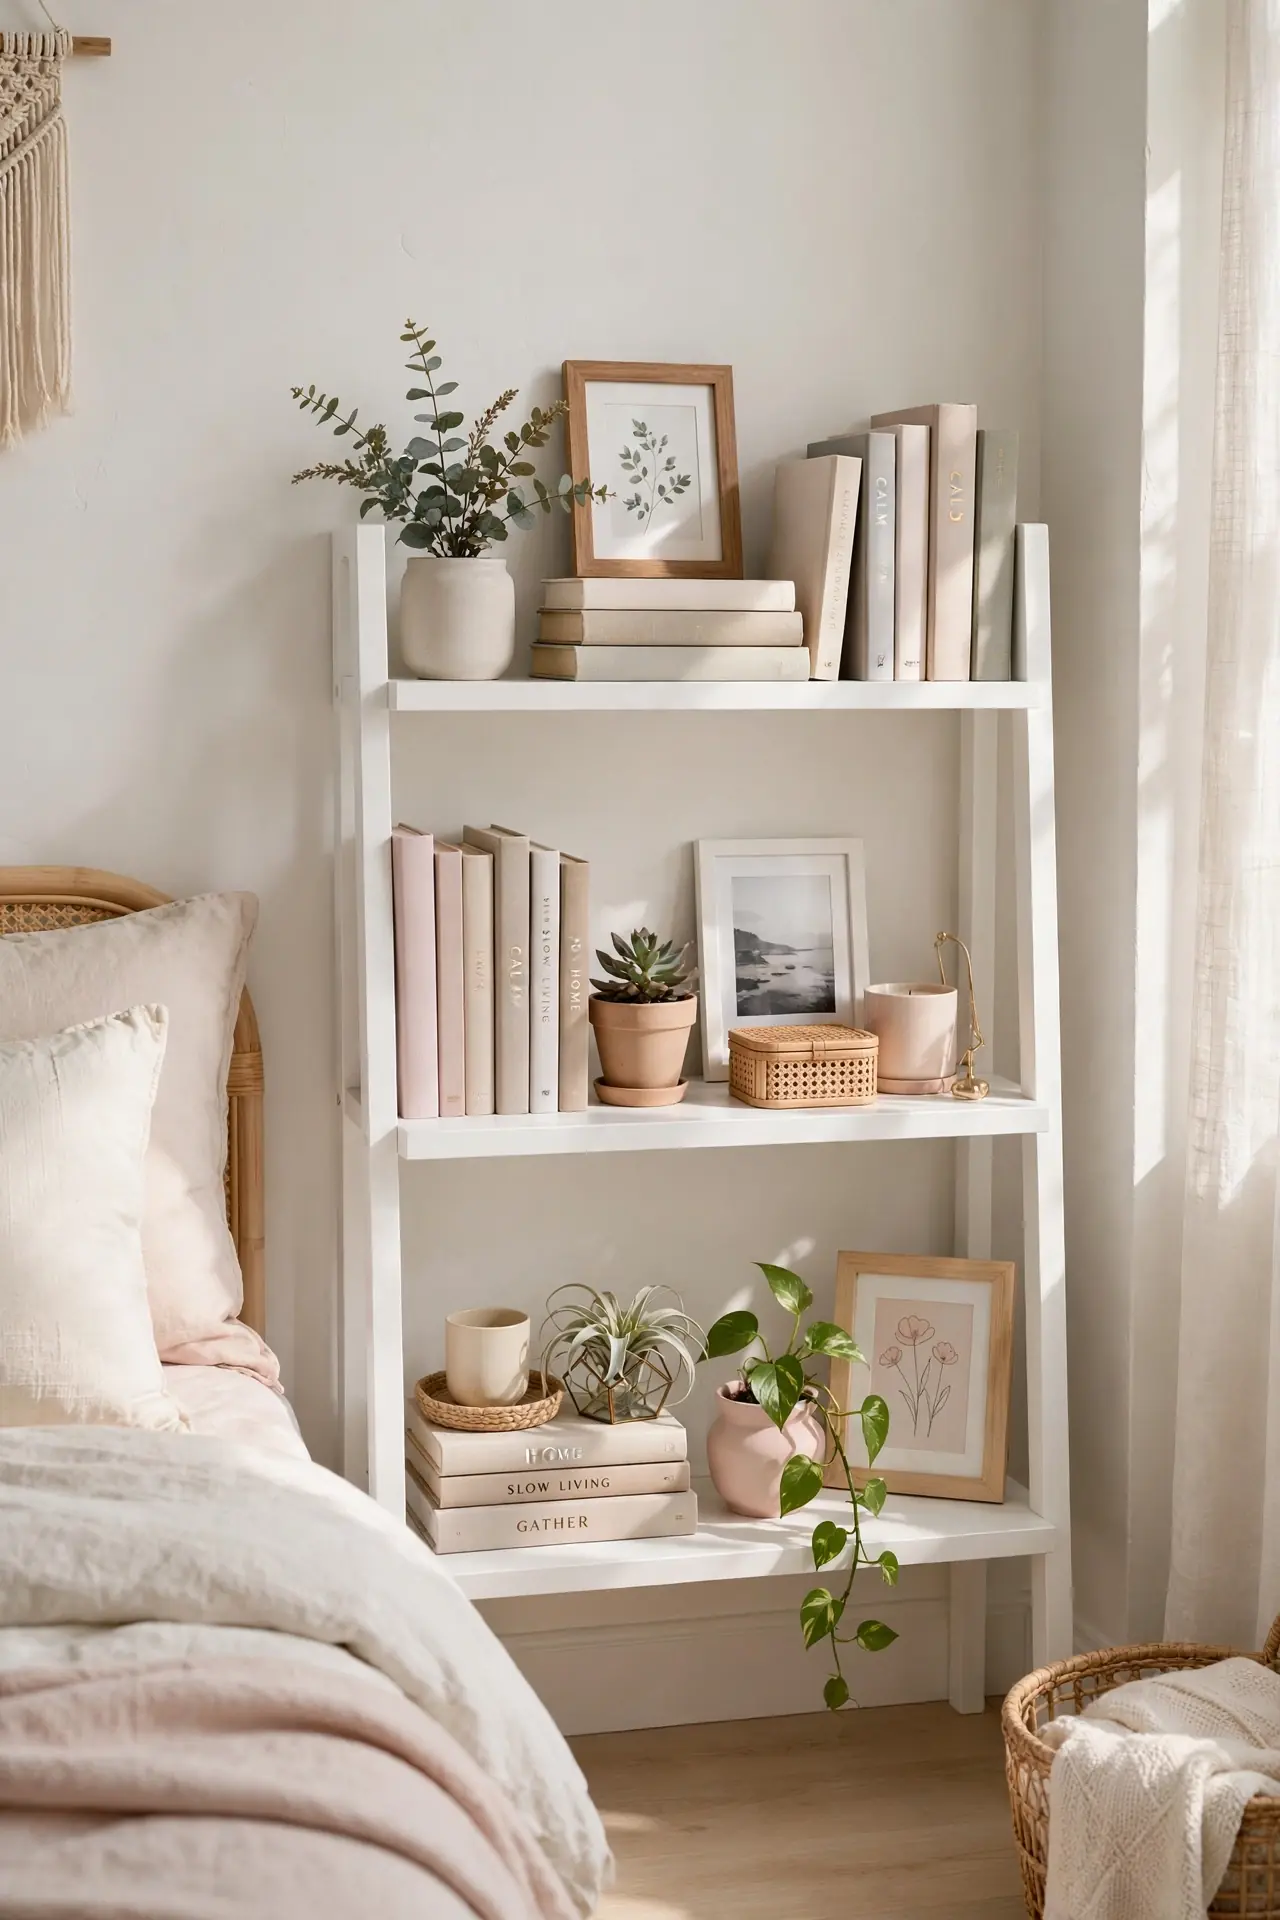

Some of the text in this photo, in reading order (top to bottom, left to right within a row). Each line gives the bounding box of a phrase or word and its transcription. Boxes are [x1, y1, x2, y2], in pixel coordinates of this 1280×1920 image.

[875, 476, 888, 527] CALM
[541, 977, 551, 1024] LIVING
[569, 969, 582, 1012] HOME
[525, 1446, 583, 1465] HOME
[507, 1477, 611, 1496] SLOW LIVING
[516, 1515, 589, 1533] GATHER
